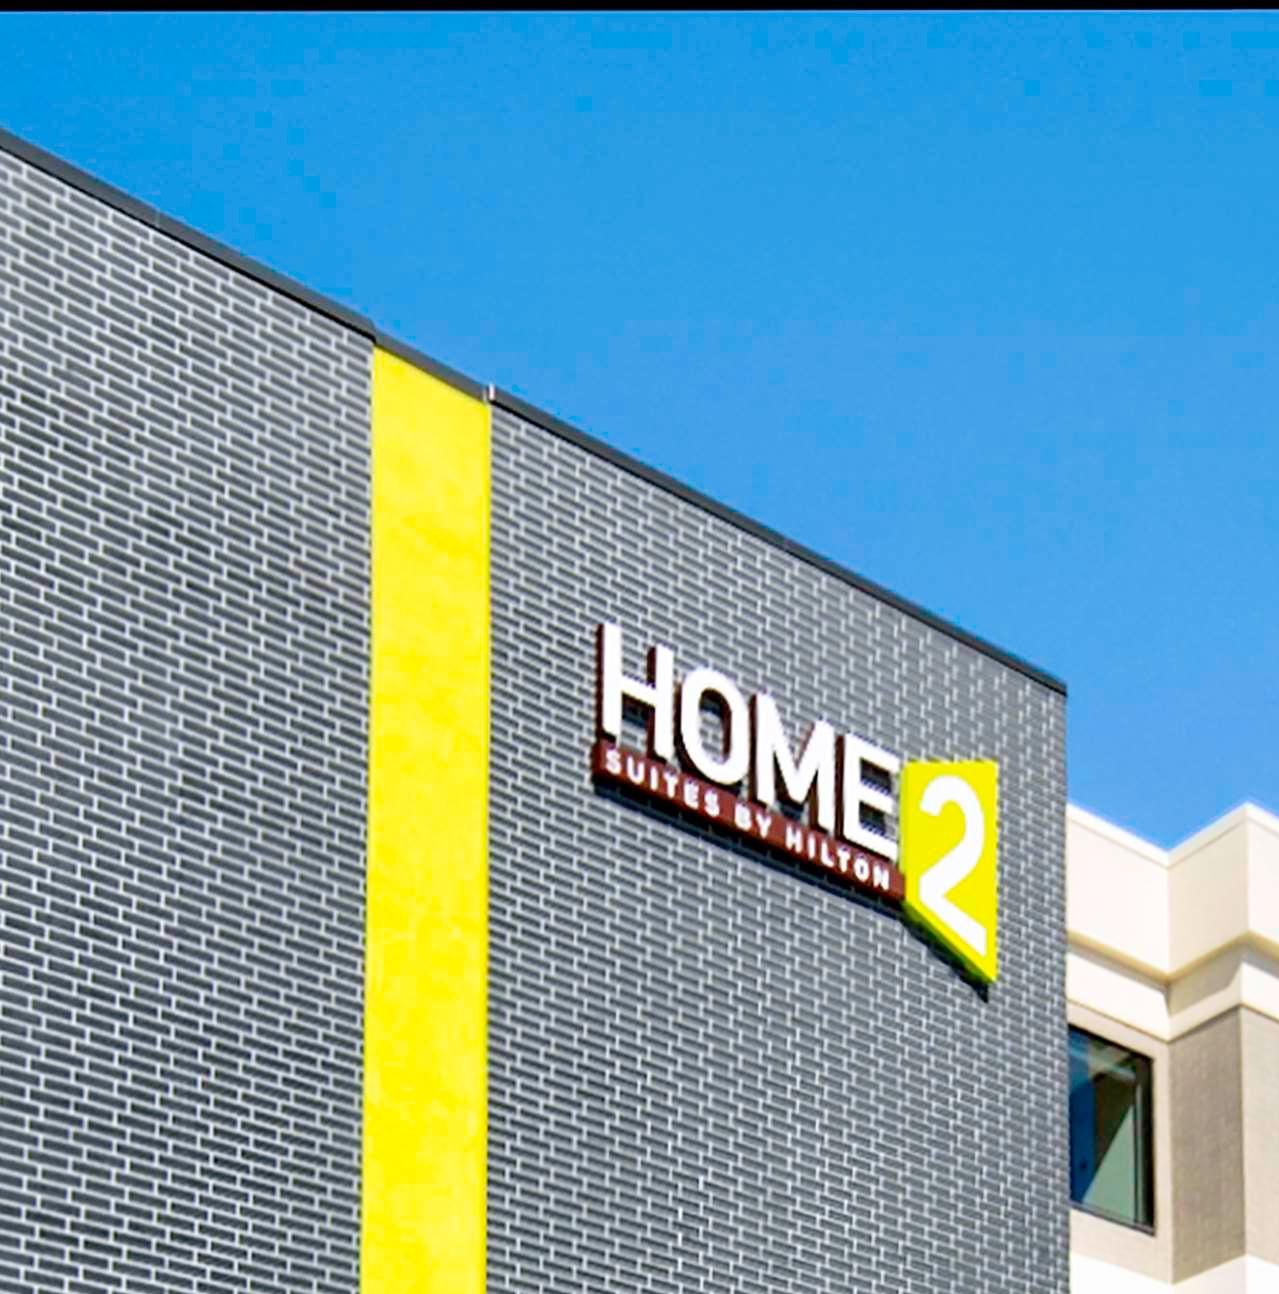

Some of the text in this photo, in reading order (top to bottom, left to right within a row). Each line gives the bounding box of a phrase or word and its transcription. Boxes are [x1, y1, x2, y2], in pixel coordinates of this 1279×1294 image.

[599, 622, 988, 958] HOME 2
[605, 747, 890, 891] SUITES BY HILTON
